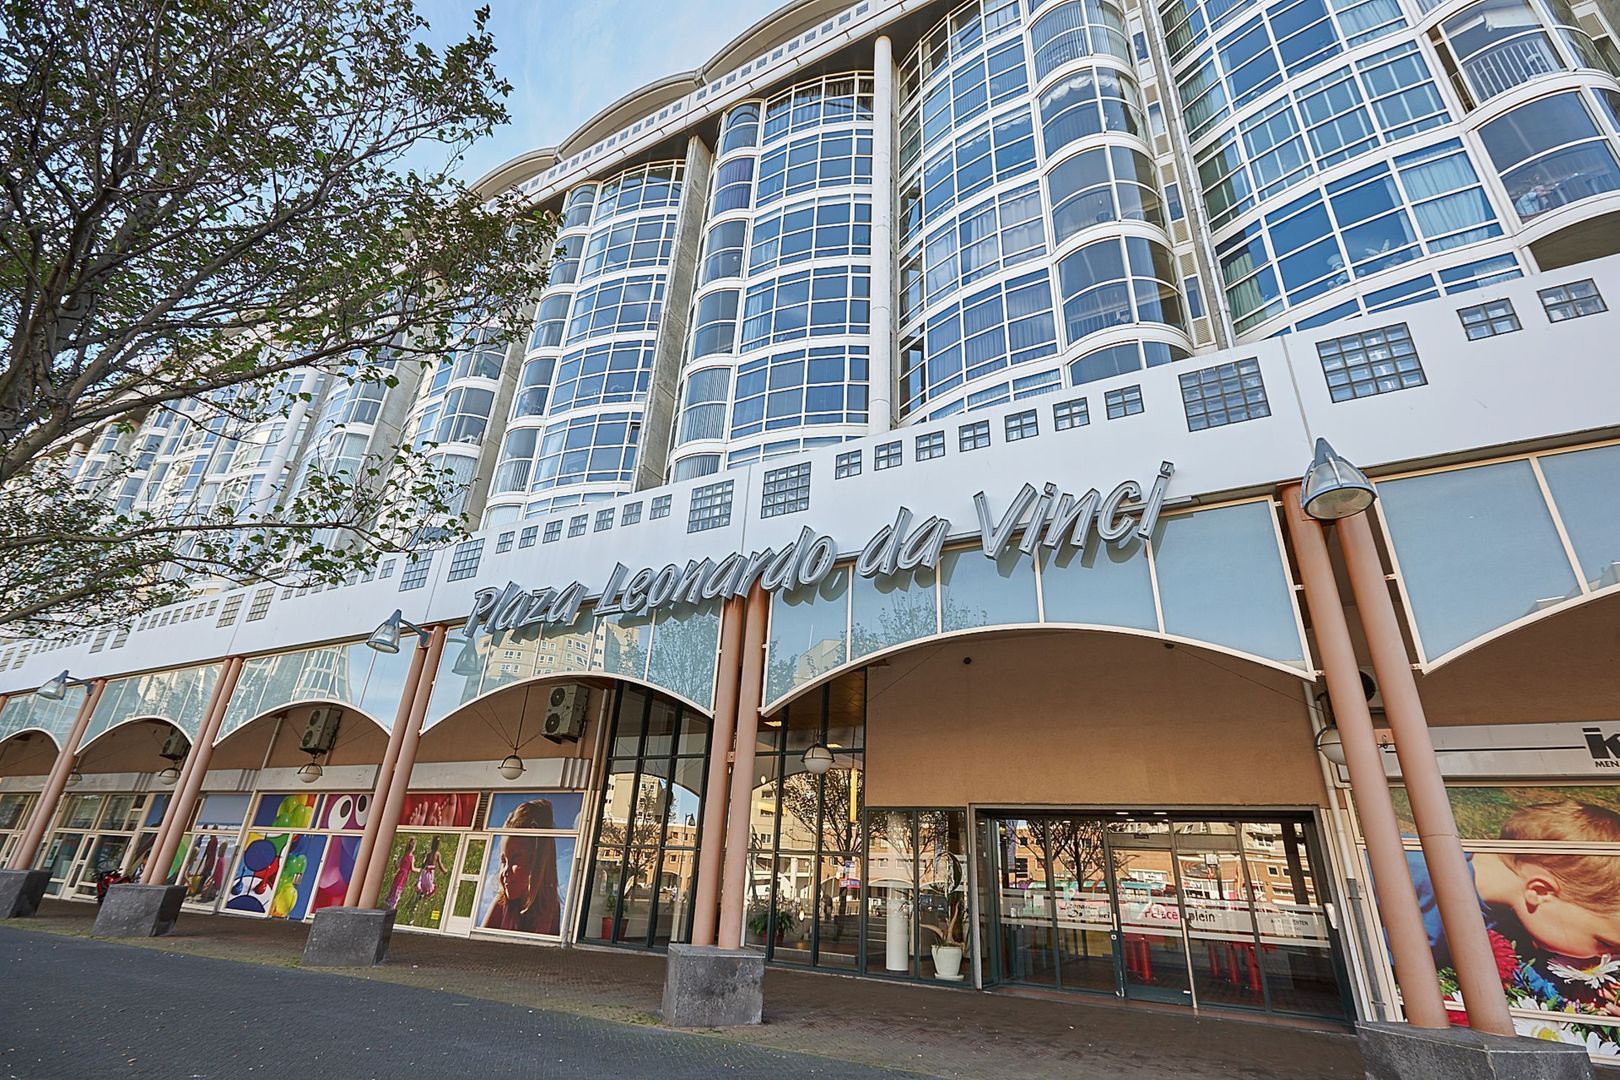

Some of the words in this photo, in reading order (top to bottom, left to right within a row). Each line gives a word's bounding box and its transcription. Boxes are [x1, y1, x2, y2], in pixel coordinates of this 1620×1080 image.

[461, 580, 589, 638] Plaza
[592, 525, 838, 616] Leonardo
[856, 505, 952, 578] da
[973, 460, 1175, 560] Vinci
